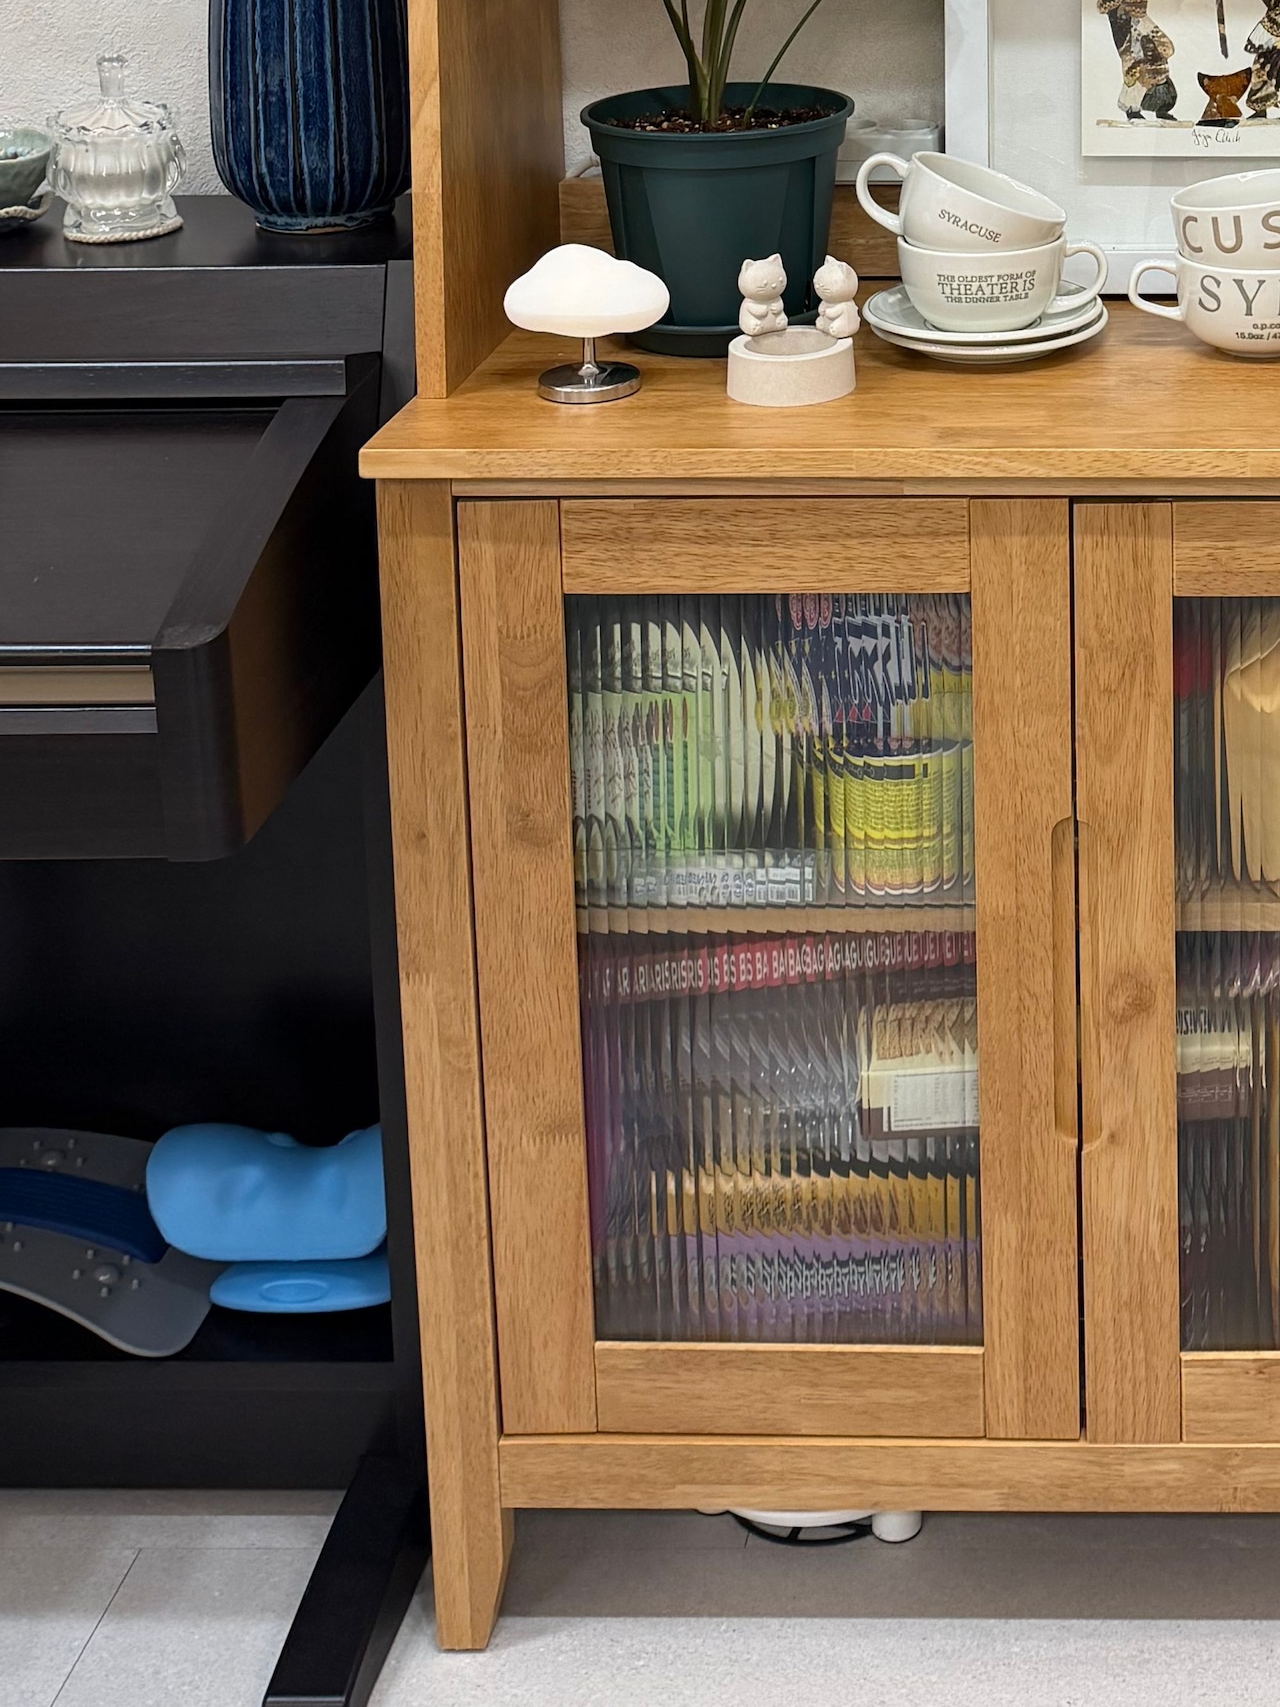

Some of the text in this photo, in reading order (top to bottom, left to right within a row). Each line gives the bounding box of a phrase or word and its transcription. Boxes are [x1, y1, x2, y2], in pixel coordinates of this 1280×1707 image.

[938, 208, 1002, 244] SYRACUSE
[937, 269, 1037, 283] THE OLDEST FORM OF
[938, 278, 1035, 295] THEATER IS
[1003, 293, 1029, 302] TABLE
